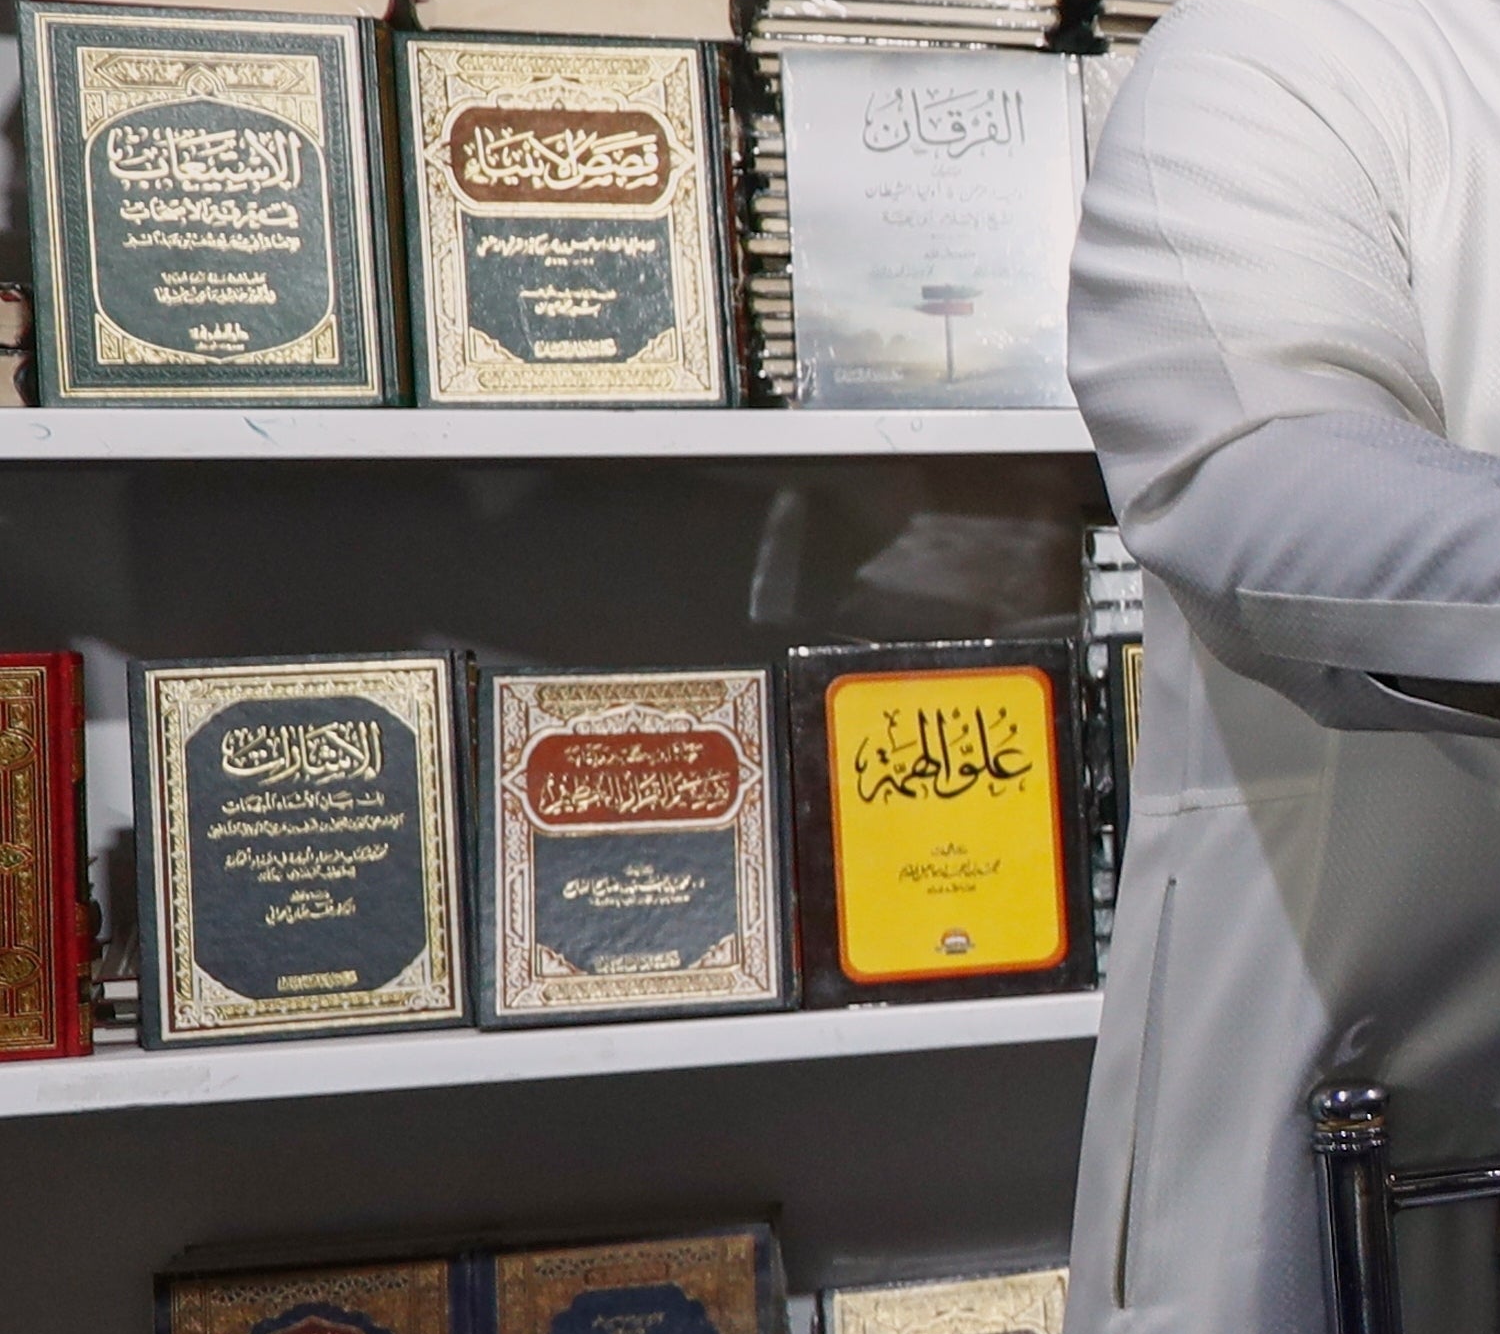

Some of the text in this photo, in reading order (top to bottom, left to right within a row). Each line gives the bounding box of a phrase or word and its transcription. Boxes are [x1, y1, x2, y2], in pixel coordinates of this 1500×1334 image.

[463, 126, 660, 190] قصص الأنبياء
[863, 87, 1026, 159] الفرقان
[107, 126, 303, 194] الاستيعاب
[854, 706, 1034, 804] علو الهمة
